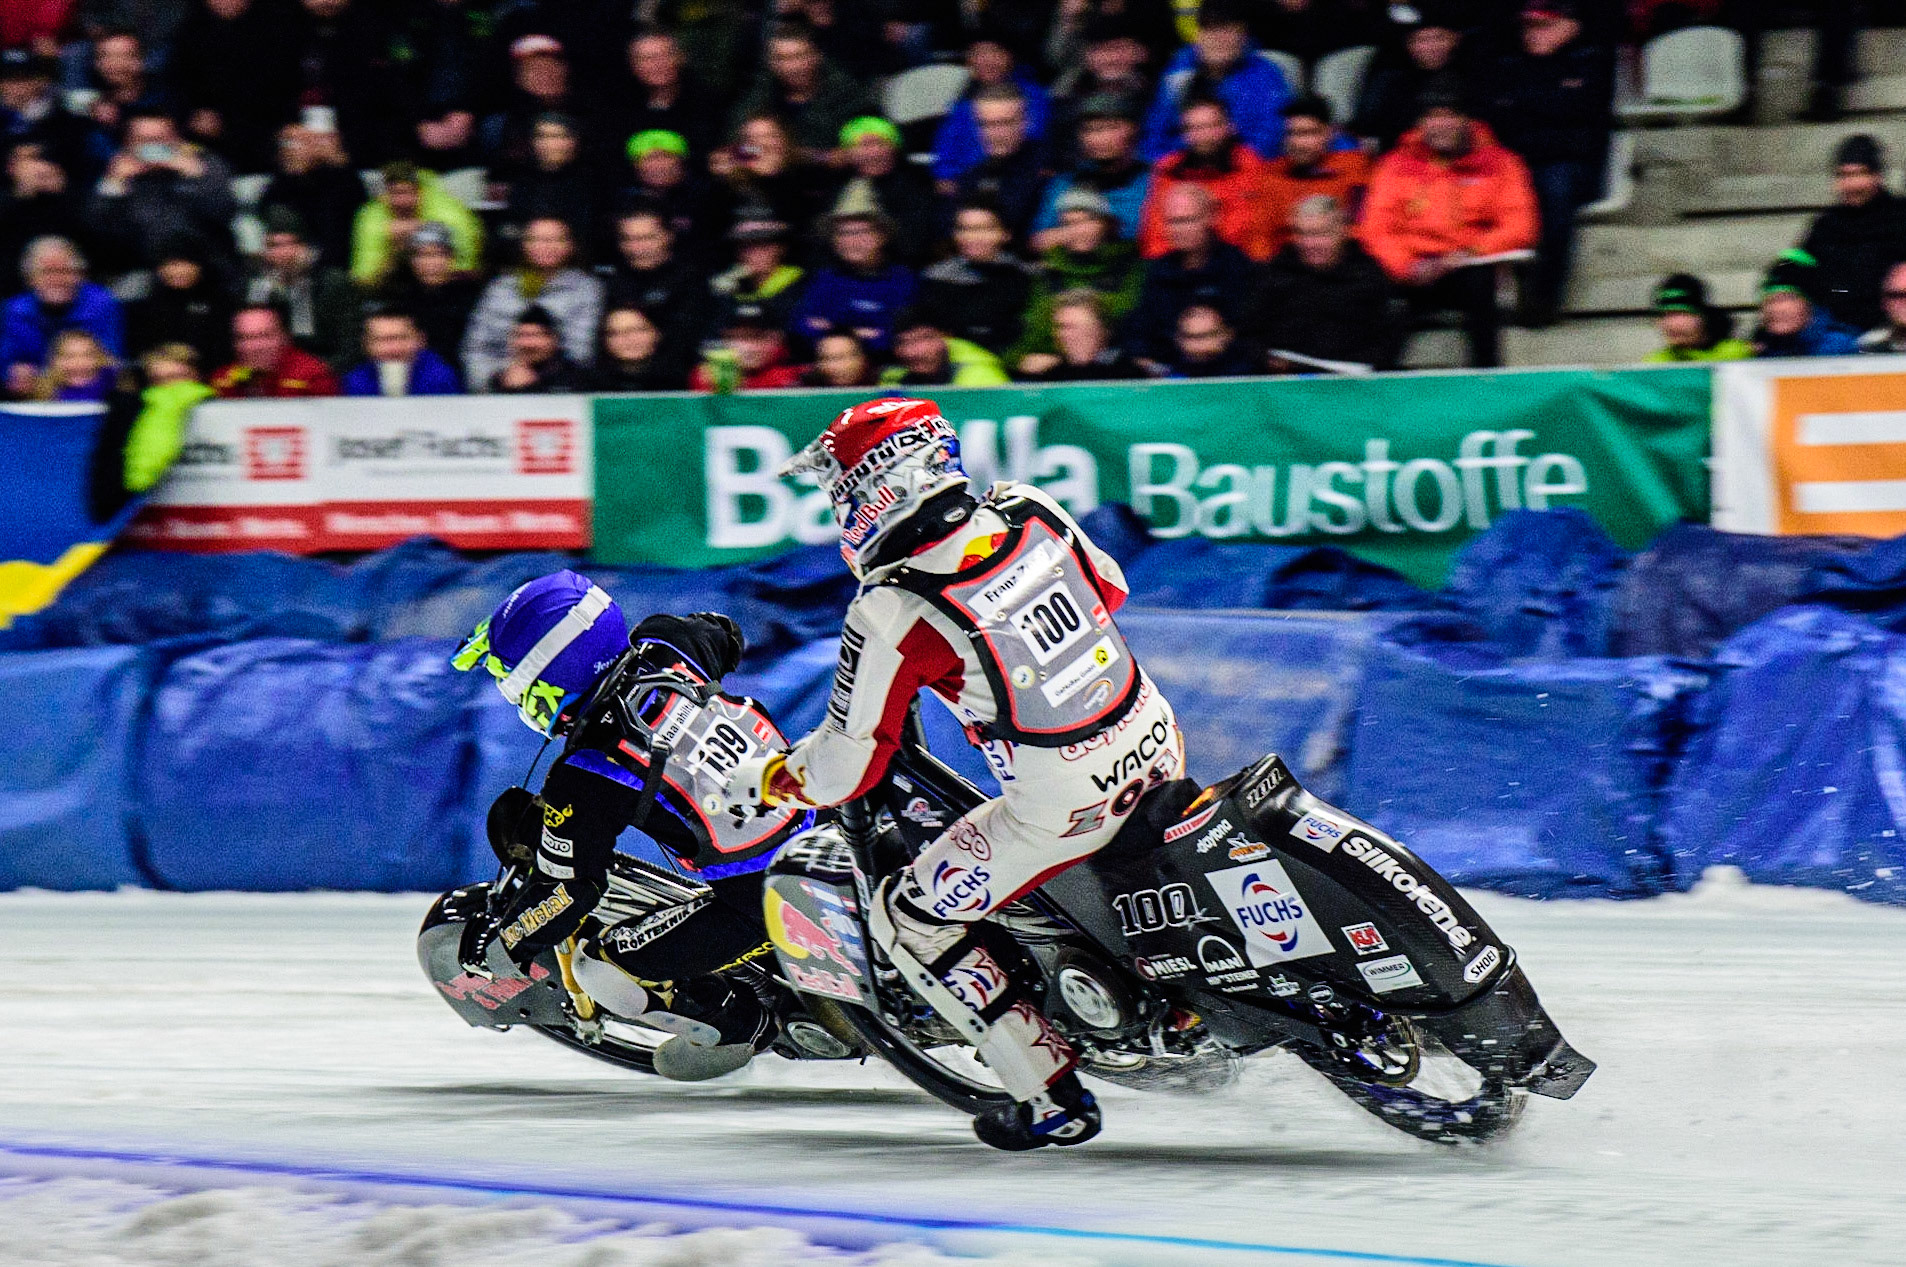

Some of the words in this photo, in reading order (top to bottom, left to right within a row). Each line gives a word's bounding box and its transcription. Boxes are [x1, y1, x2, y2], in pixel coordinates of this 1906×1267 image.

[1128, 429, 1589, 538] Baustoffe
[842, 511, 869, 546] Red
[861, 485, 897, 523] Bull
[1021, 592, 1080, 653] 100
[699, 723, 748, 779] 199
[1091, 721, 1167, 792] WACO
[1303, 816, 1343, 838] FUCHS
[932, 865, 991, 918] FUCHS
[1112, 882, 1200, 937] 100
[1236, 898, 1304, 929] FUCHS
[1369, 963, 1406, 976] WIMMER
[1470, 951, 1497, 978] SHOEI
